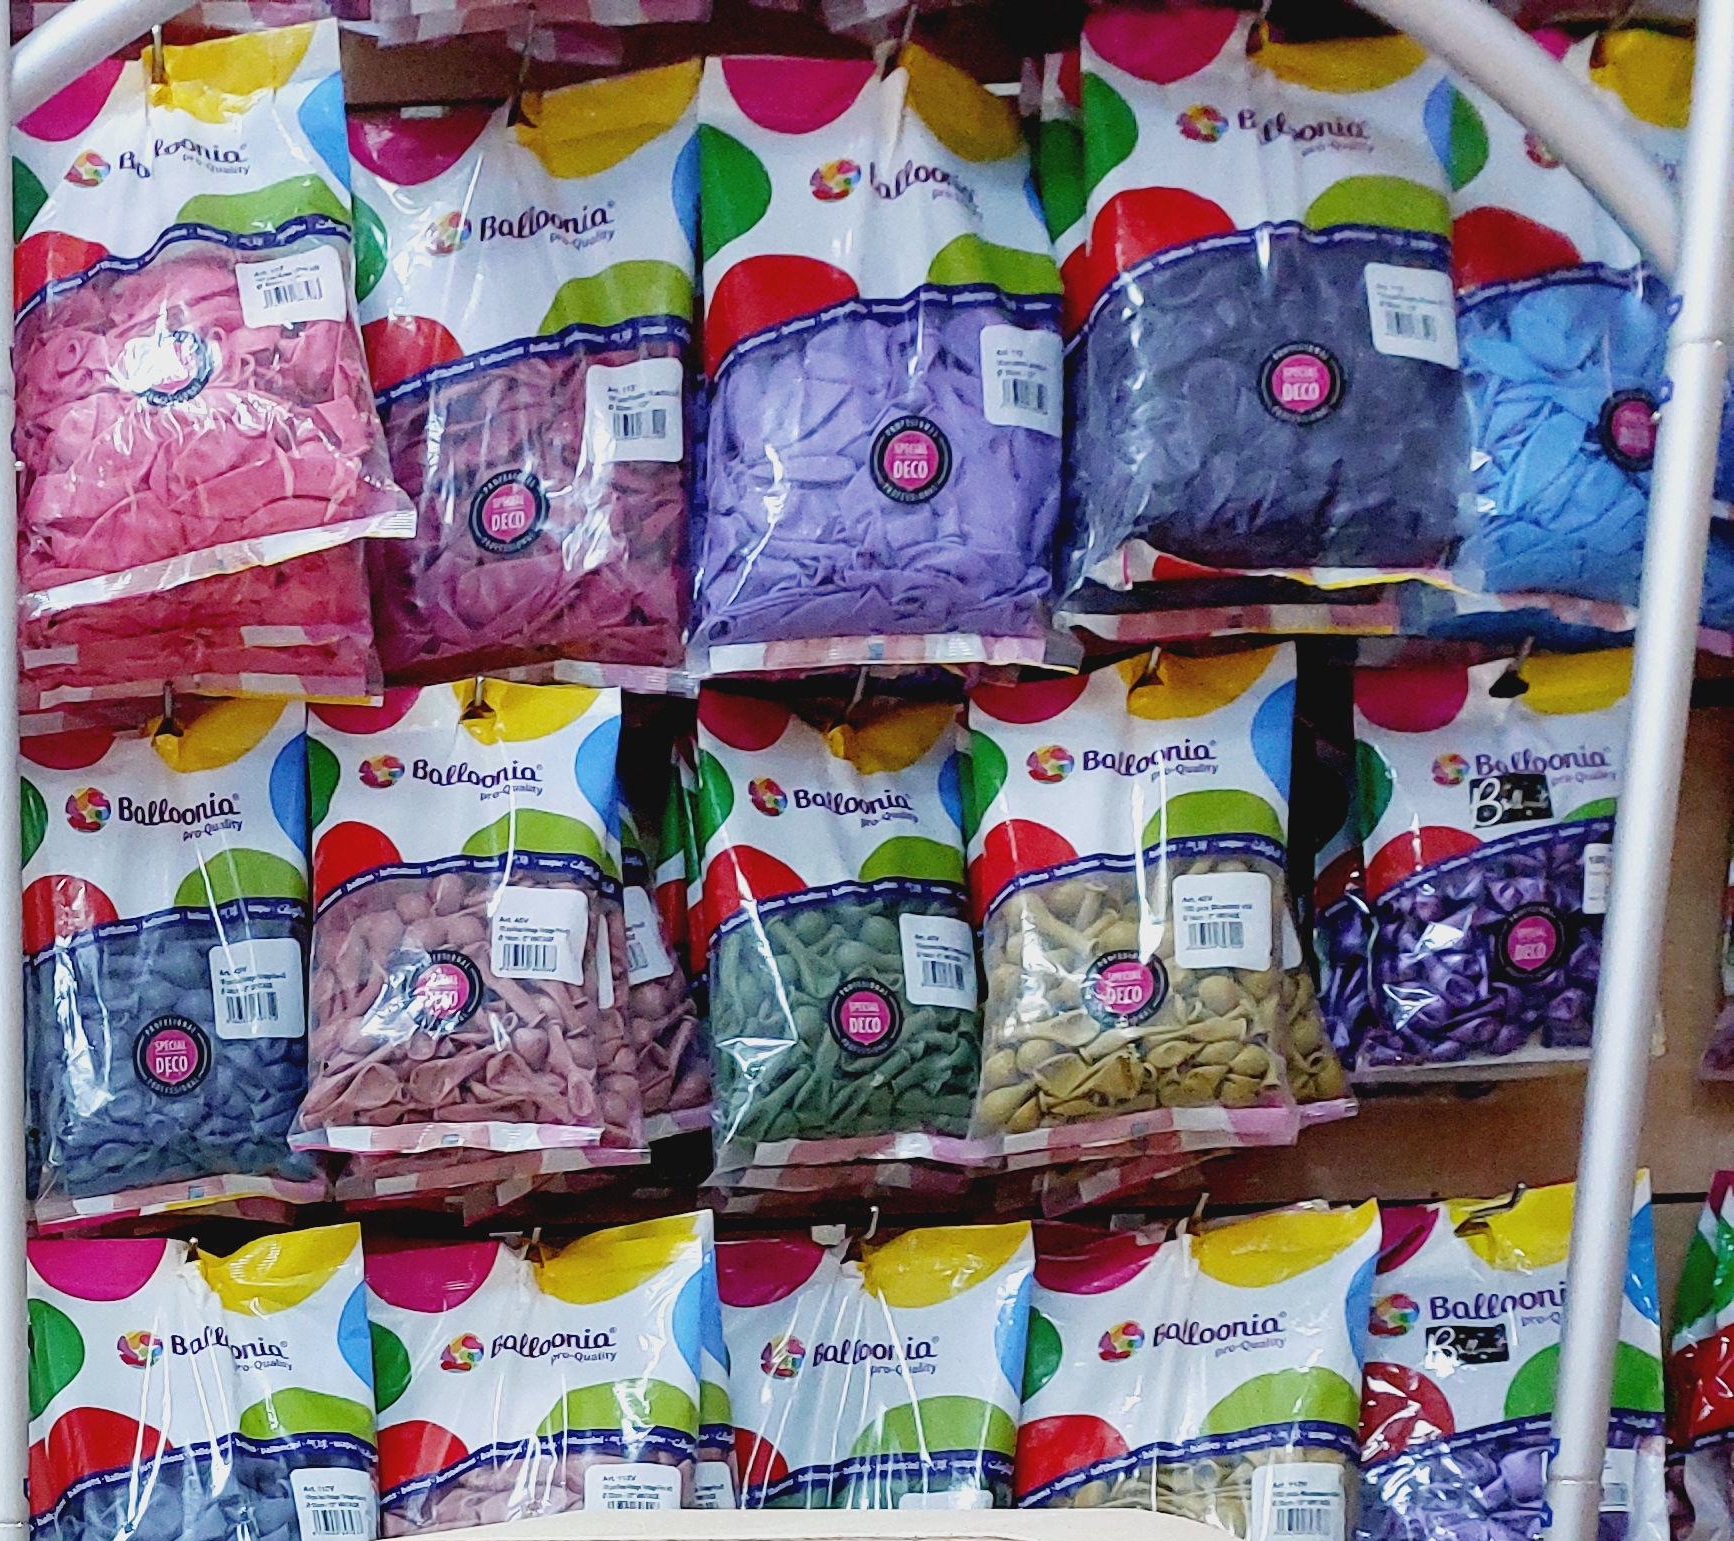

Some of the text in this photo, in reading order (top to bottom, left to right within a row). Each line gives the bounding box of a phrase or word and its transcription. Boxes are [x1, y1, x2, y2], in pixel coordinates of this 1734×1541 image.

[480, 203, 614, 242] Balloonia
[1281, 382, 1319, 402] DECO
[893, 459, 930, 480] DECO
[491, 513, 526, 532] DECO
[412, 758, 542, 789] Balloonia
[1475, 745, 1612, 777] Balloonia
[117, 792, 242, 827] Balloonia
[793, 788, 913, 817] Balloonia
[849, 1017, 882, 1034] DECO
[155, 1055, 188, 1074] DECO
[1429, 1281, 1567, 1321] Ballooni
[551, 1350, 618, 1365] pro-Quality
